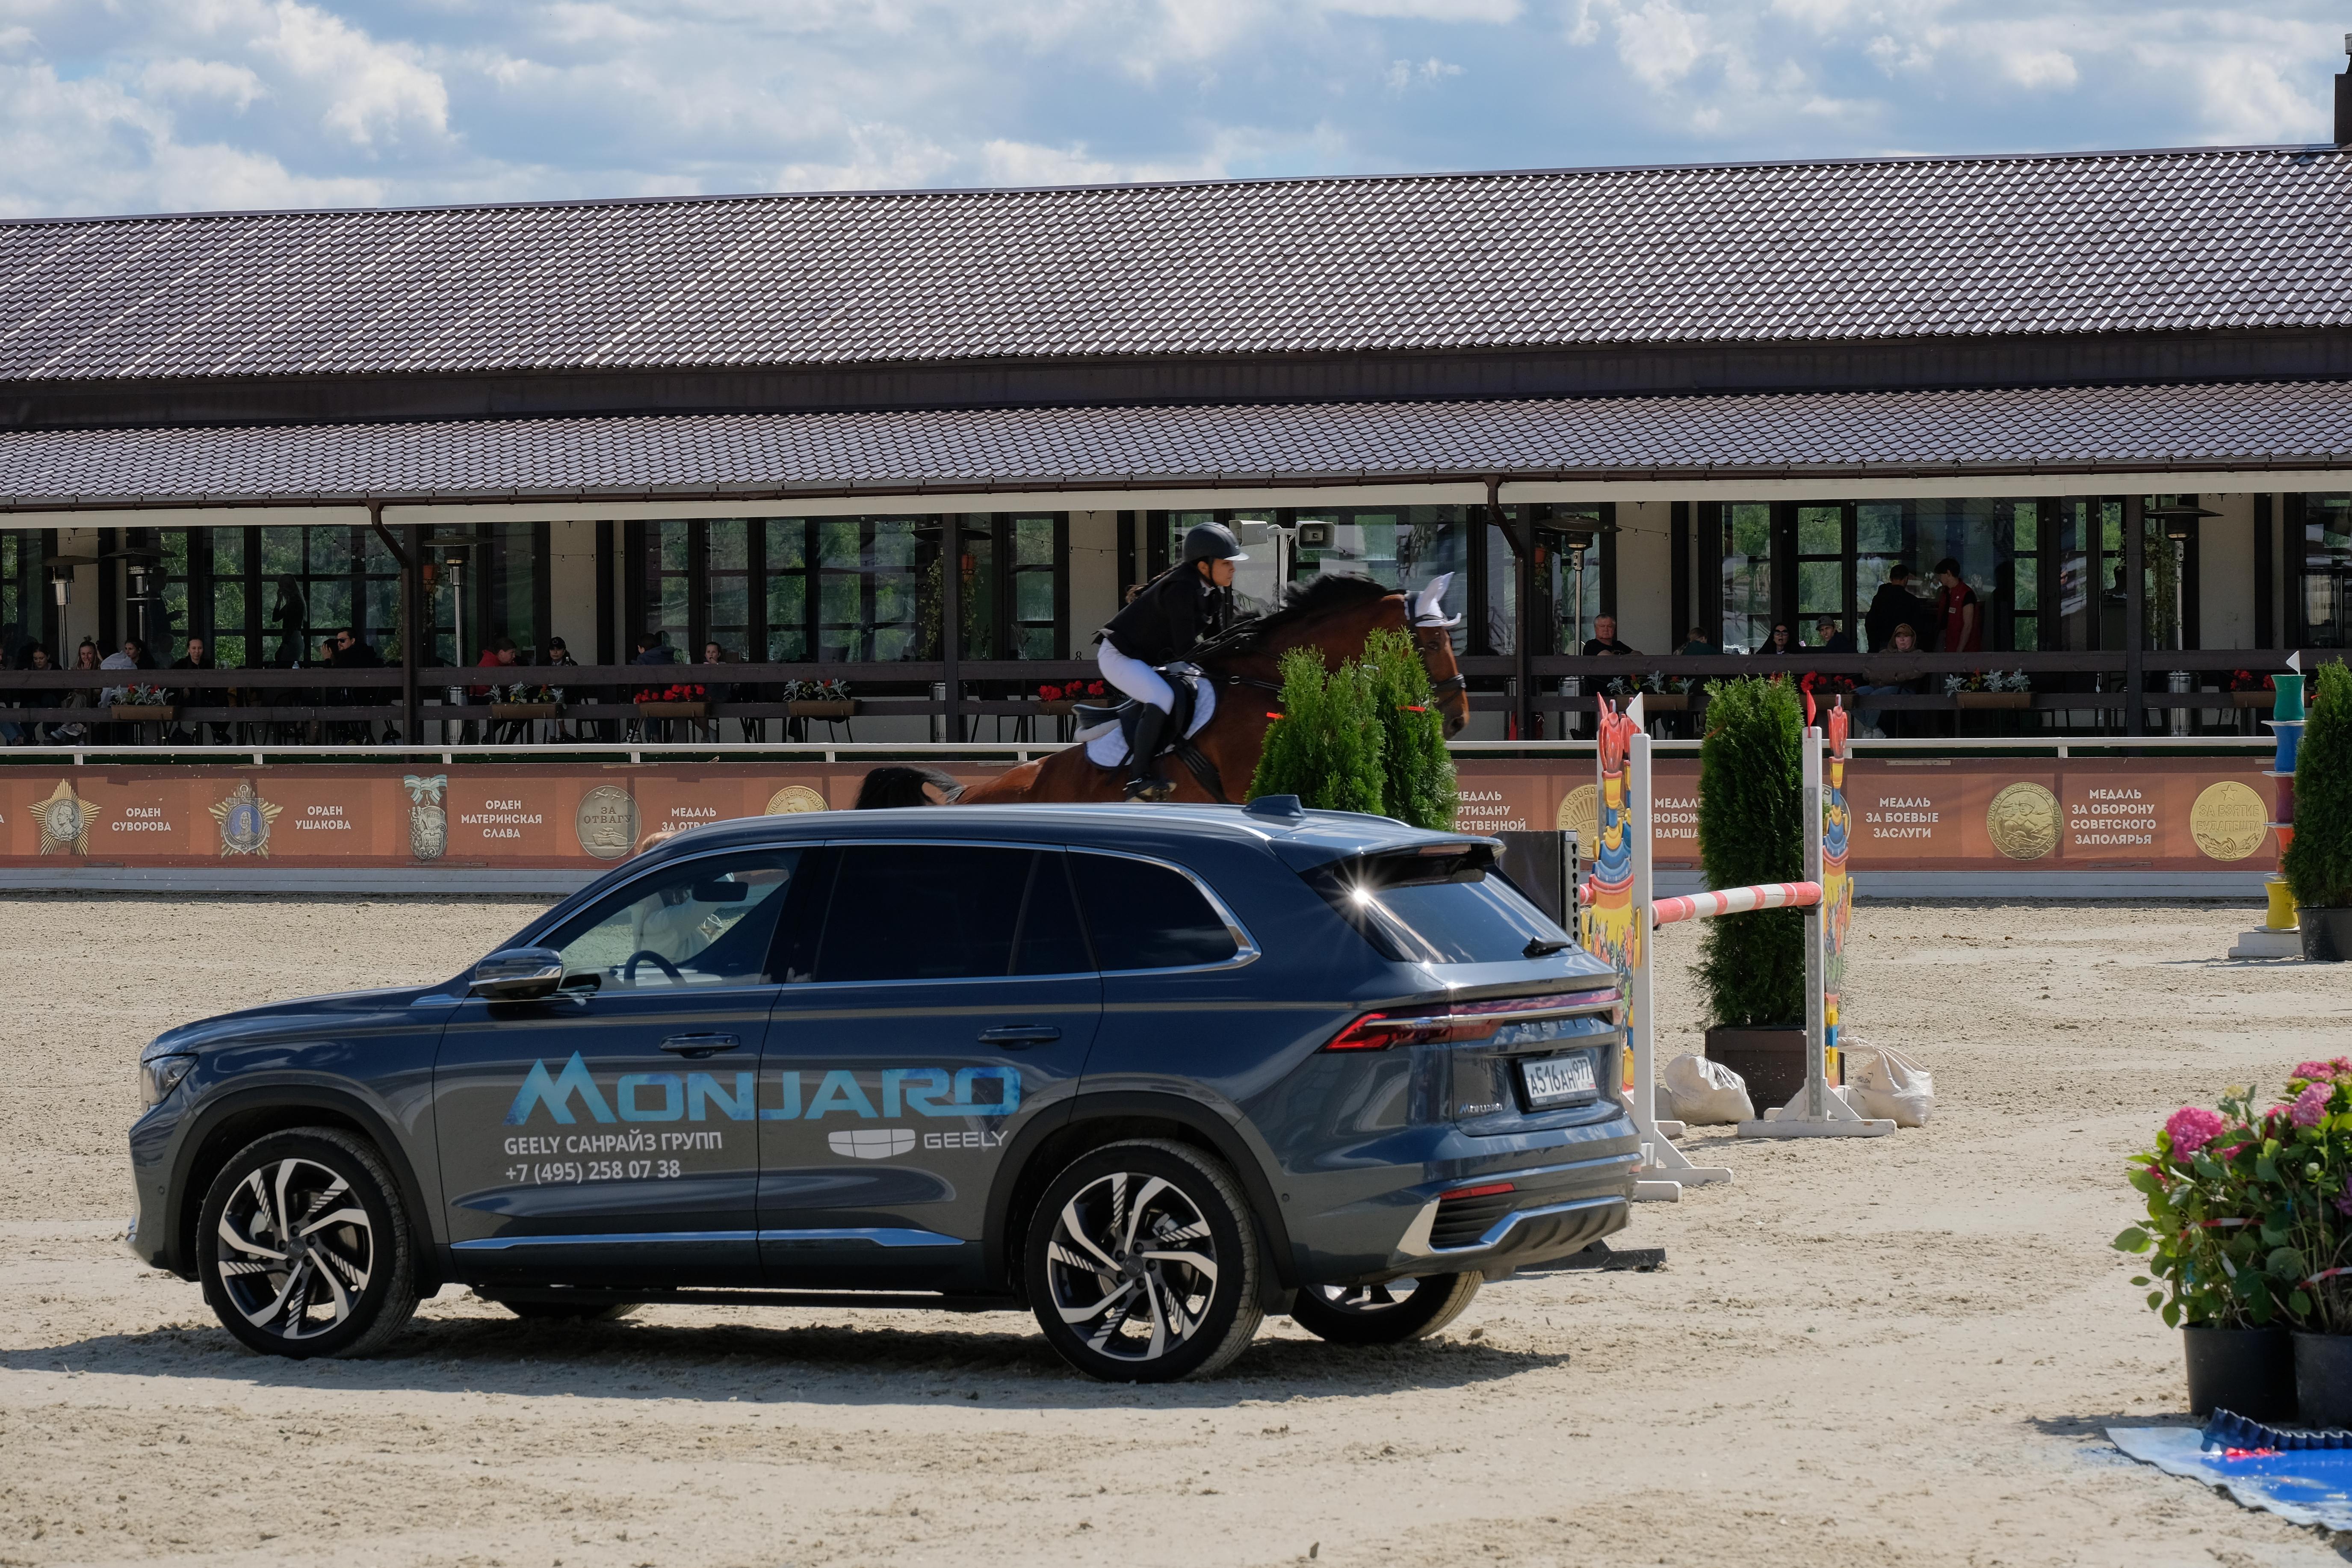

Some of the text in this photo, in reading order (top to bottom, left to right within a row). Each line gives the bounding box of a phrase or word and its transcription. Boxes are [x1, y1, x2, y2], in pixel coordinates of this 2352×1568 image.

[785, 788, 802, 799] ДЕЛО
[804, 790, 825, 811] ПРАВО
[1564, 787, 1596, 811] ОСВОБО
[2089, 789, 2142, 800] МЕДАЛЬ
[485, 800, 521, 810] ОРДЕН
[1879, 797, 1931, 808] МЕДАЛЬ
[126, 808, 161, 818] ОРДЕН
[307, 806, 343, 816] ОРДЕН
[601, 806, 617, 815] ЗА
[671, 807, 717, 818] МЕДАЛЬ
[1457, 806, 1511, 815] РТИЗАНУ
[2071, 804, 2155, 814] ЗА ОБОРОНУ
[2199, 804, 2259, 817] ЗА ВЗЯТИЕ
[461, 814, 542, 824] МАТЕРИНСКАЯ
[583, 815, 633, 824] ОТВАГУ
[1561, 814, 1569, 826] ЗА
[1866, 812, 1939, 823] ЗА БОЕВЫЕ
[112, 821, 171, 831] СУВОРОВА
[295, 820, 351, 830] УШАКОВА
[662, 821, 676, 832] ЗА
[1455, 818, 1526, 830] ЕСТВЕННОЙ
[2071, 819, 2156, 829] СОВЕТСКОГО
[2196, 821, 2261, 833] БУДАПЕШТА
[483, 828, 520, 838] СЛАВА
[1655, 828, 1700, 838] ВАРША
[1873, 828, 1931, 838] ЗАСЛУГИ
[2075, 834, 2151, 845] ЗАПОЛЯРЬЯ
[1572, 1058, 1590, 1081] 977
[502, 1050, 1021, 1126] MONJARO
[504, 1129, 722, 1155] GEELY САНРАЙЗ ГРУПП
[924, 1130, 1009, 1149] GEELY
[505, 1159, 681, 1184] +7 (495) 258 07 38
